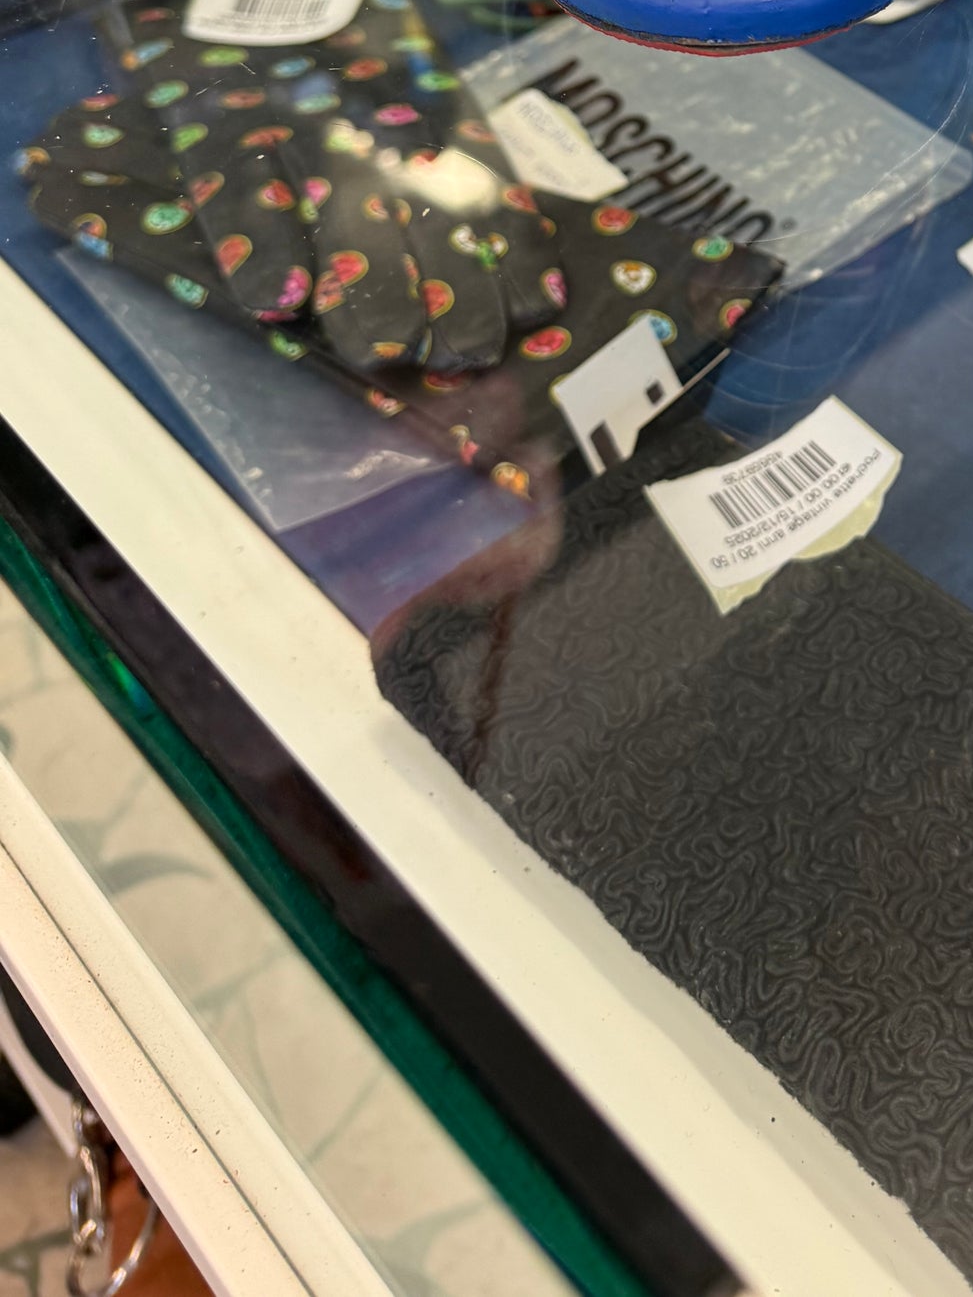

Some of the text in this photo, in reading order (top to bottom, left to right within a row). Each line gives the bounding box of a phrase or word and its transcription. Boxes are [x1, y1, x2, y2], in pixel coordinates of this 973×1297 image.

[833, 447, 882, 499] Pochette
[724, 509, 795, 548] 15/12/2025
[788, 497, 833, 533] vintage
[740, 544, 758, 560] 20
[758, 528, 785, 549] anni
[711, 555, 730, 570] 50
